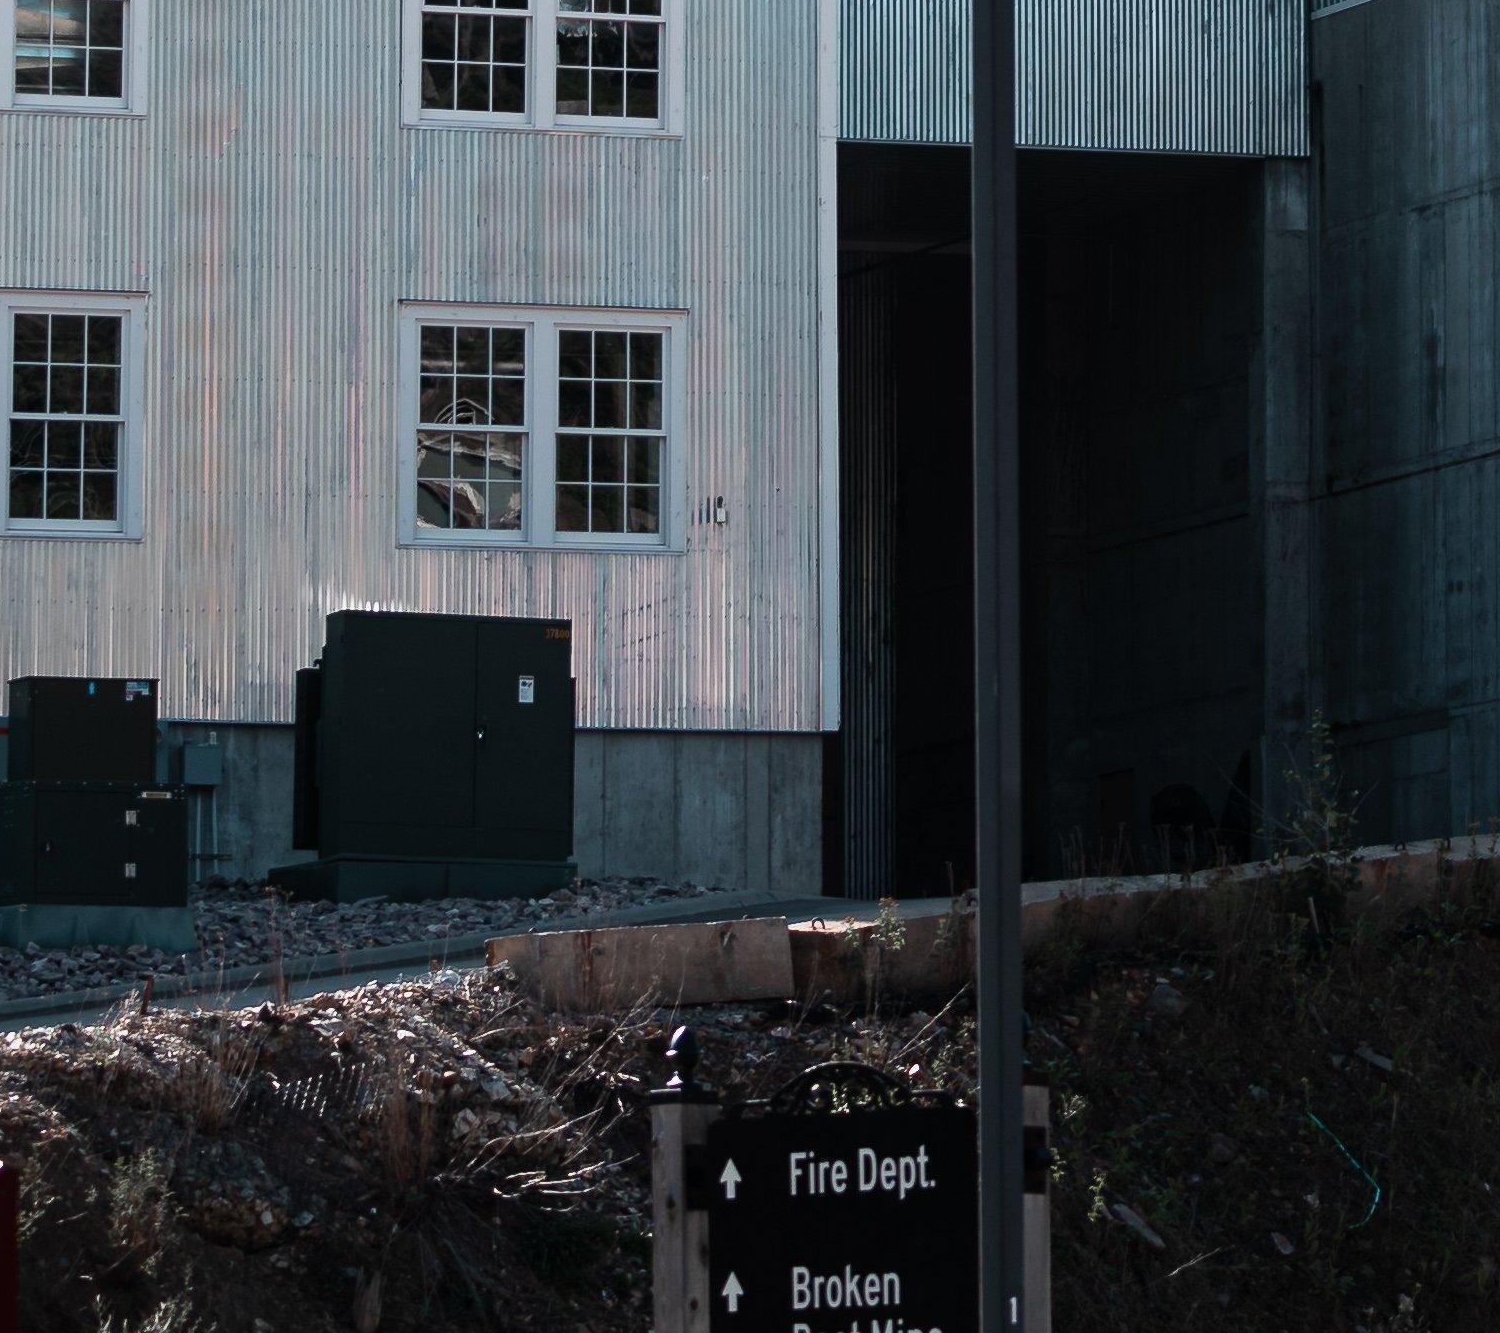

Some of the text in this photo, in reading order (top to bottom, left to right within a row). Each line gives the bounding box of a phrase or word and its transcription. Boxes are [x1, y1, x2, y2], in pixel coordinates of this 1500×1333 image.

[790, 1144, 936, 1200] Fire Dept.
[792, 1264, 901, 1310] Broken
